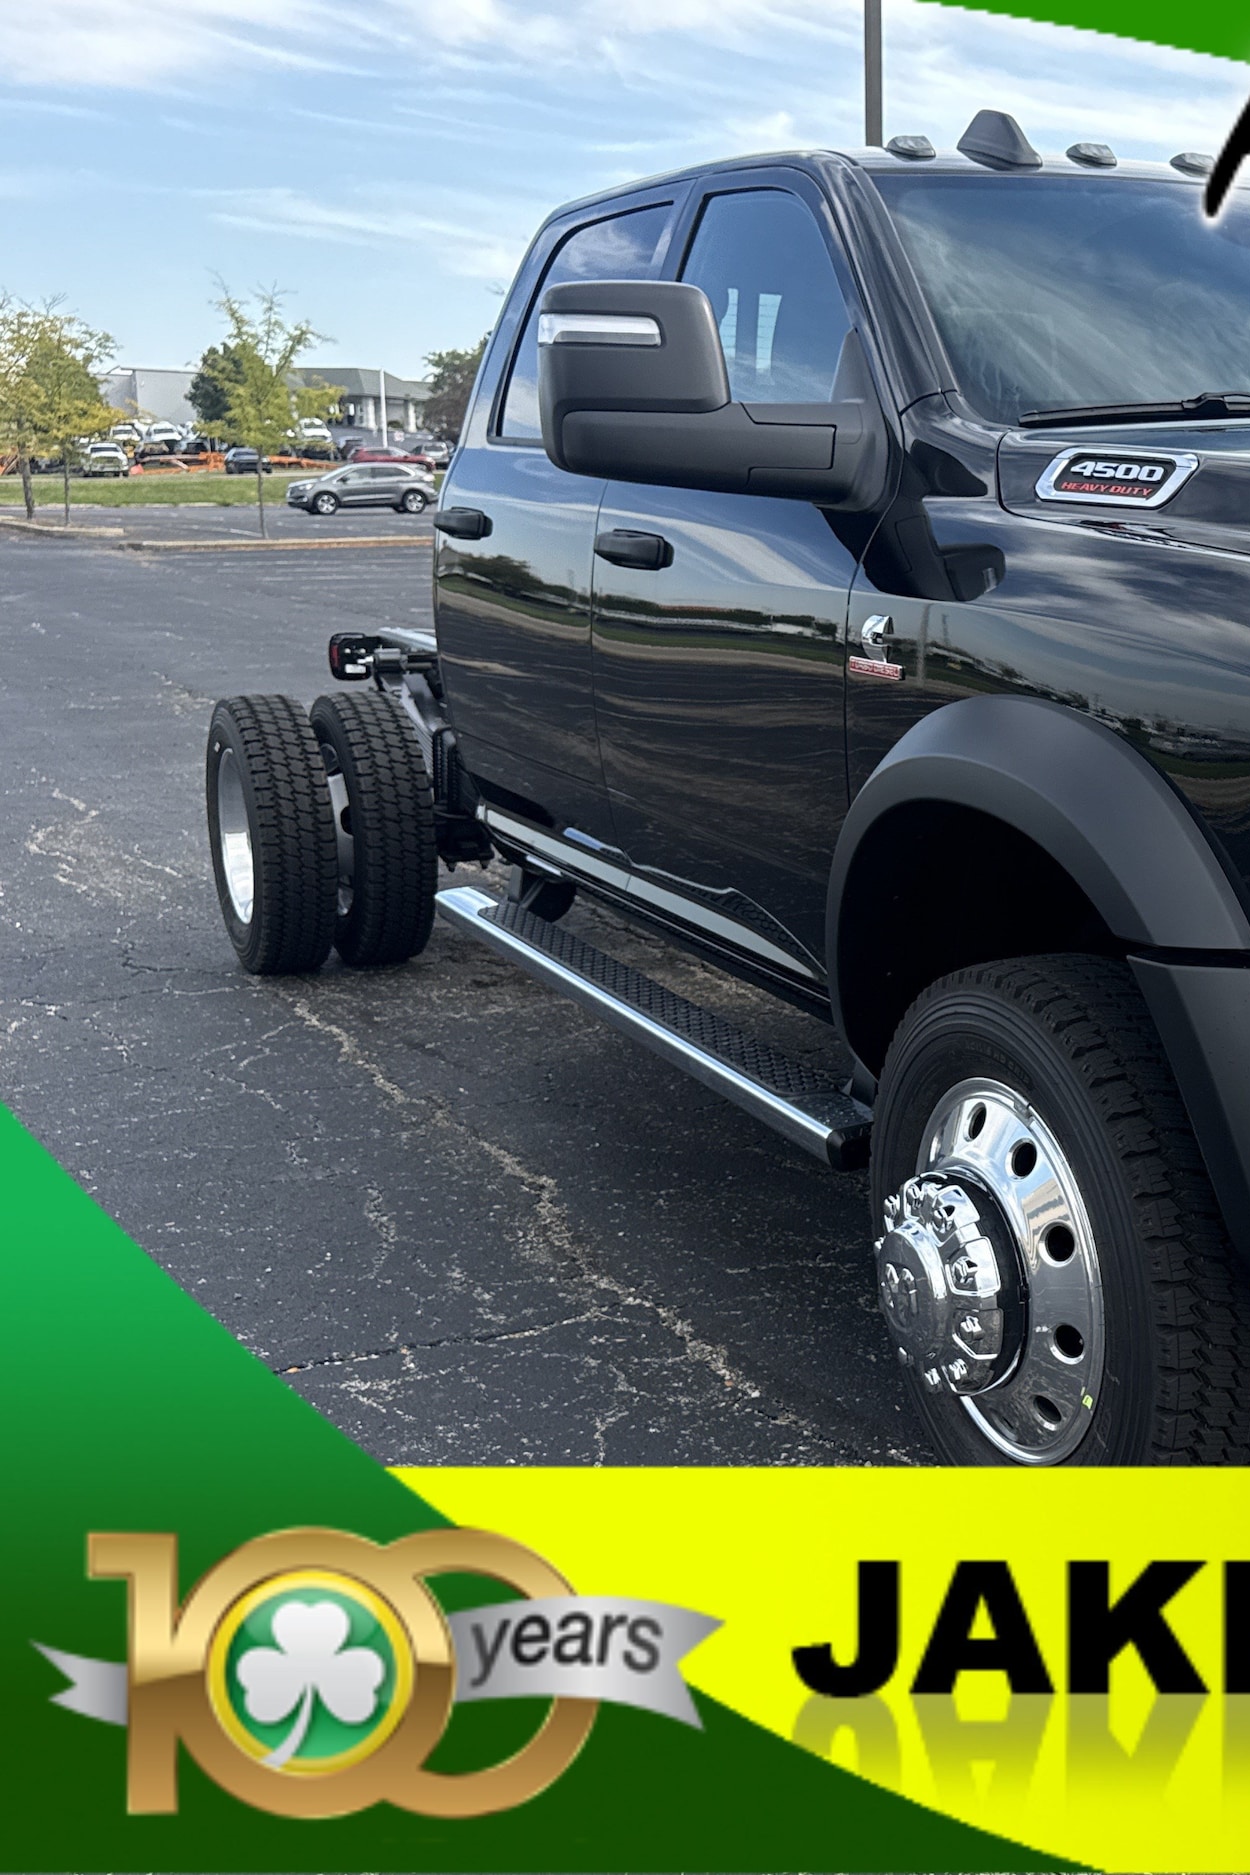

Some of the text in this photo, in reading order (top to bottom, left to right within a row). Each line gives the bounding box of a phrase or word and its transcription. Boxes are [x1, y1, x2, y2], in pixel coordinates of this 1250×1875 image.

[1070, 461, 1165, 482] 4500
[1061, 481, 1152, 496] HEAVY DUTY
